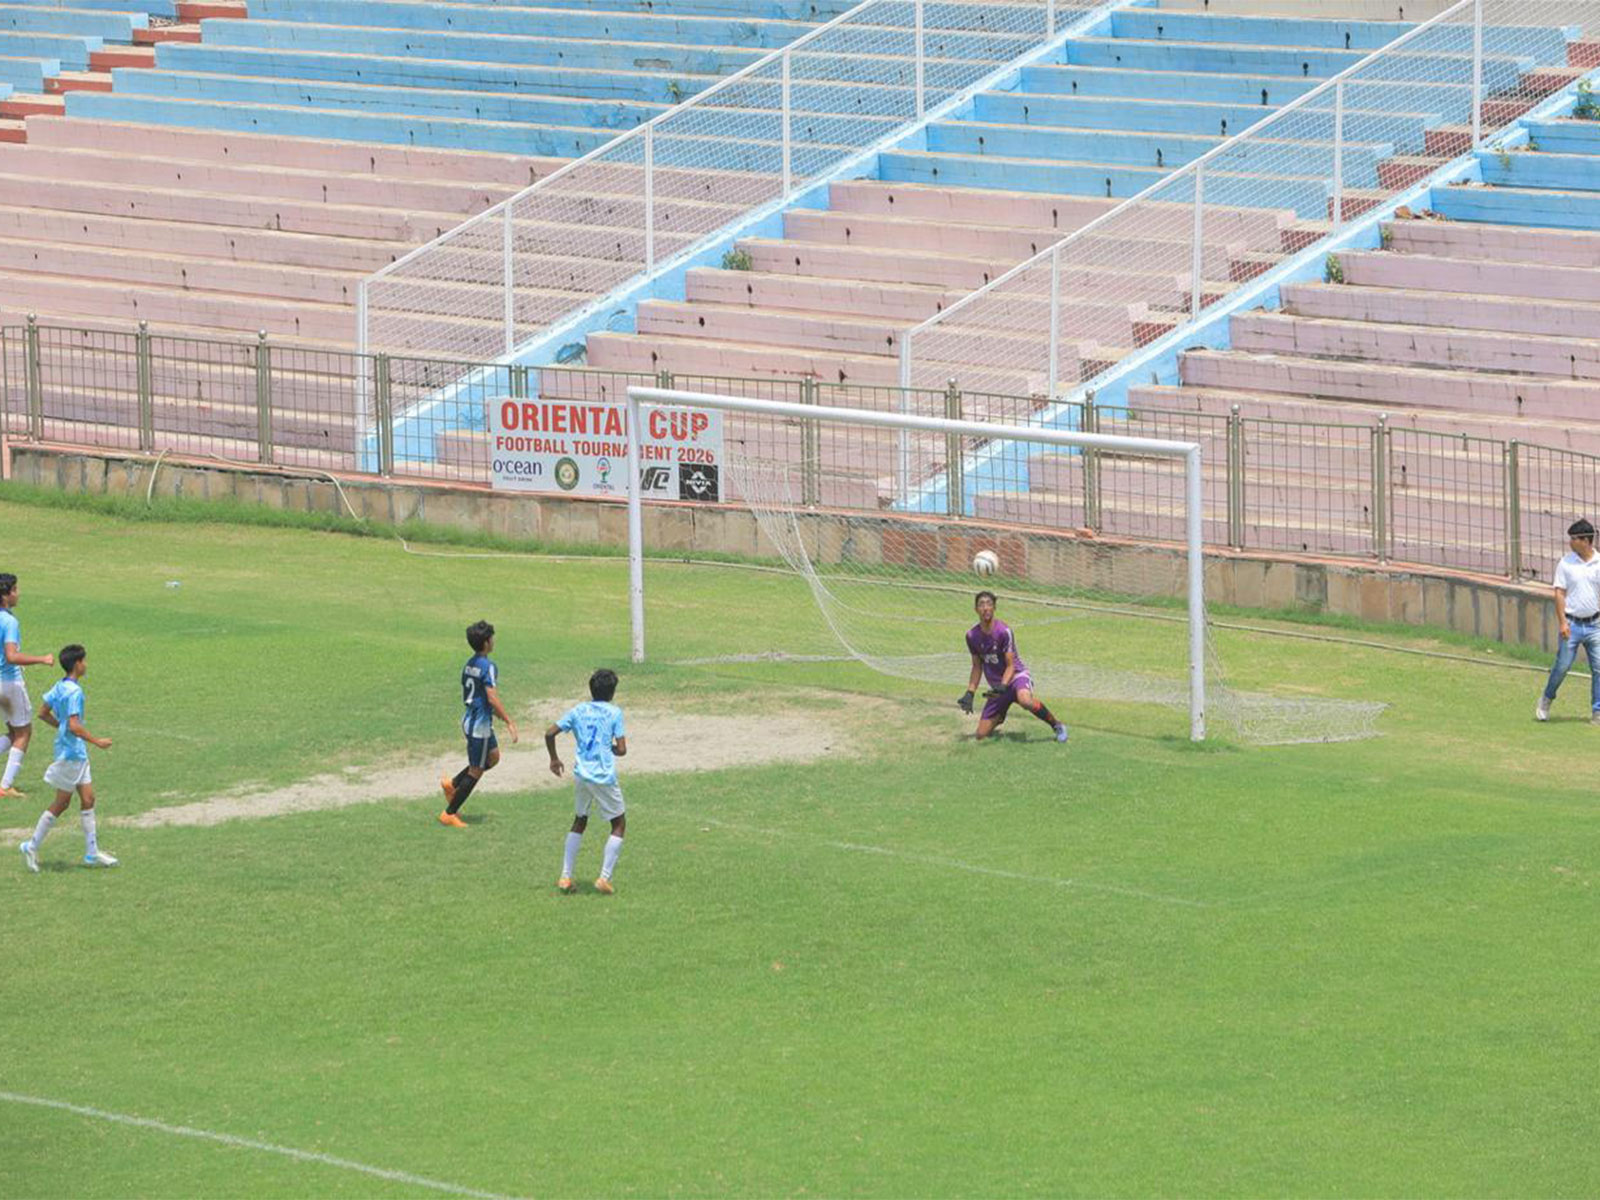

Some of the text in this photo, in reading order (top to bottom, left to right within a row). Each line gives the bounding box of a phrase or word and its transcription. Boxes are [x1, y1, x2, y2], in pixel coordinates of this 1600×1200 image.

[649, 409, 709, 441] CUP
[496, 436, 568, 455] FOOTBALL
[678, 447, 714, 464] 2026
[465, 677, 475, 704] 2
[587, 725, 597, 751] 7
